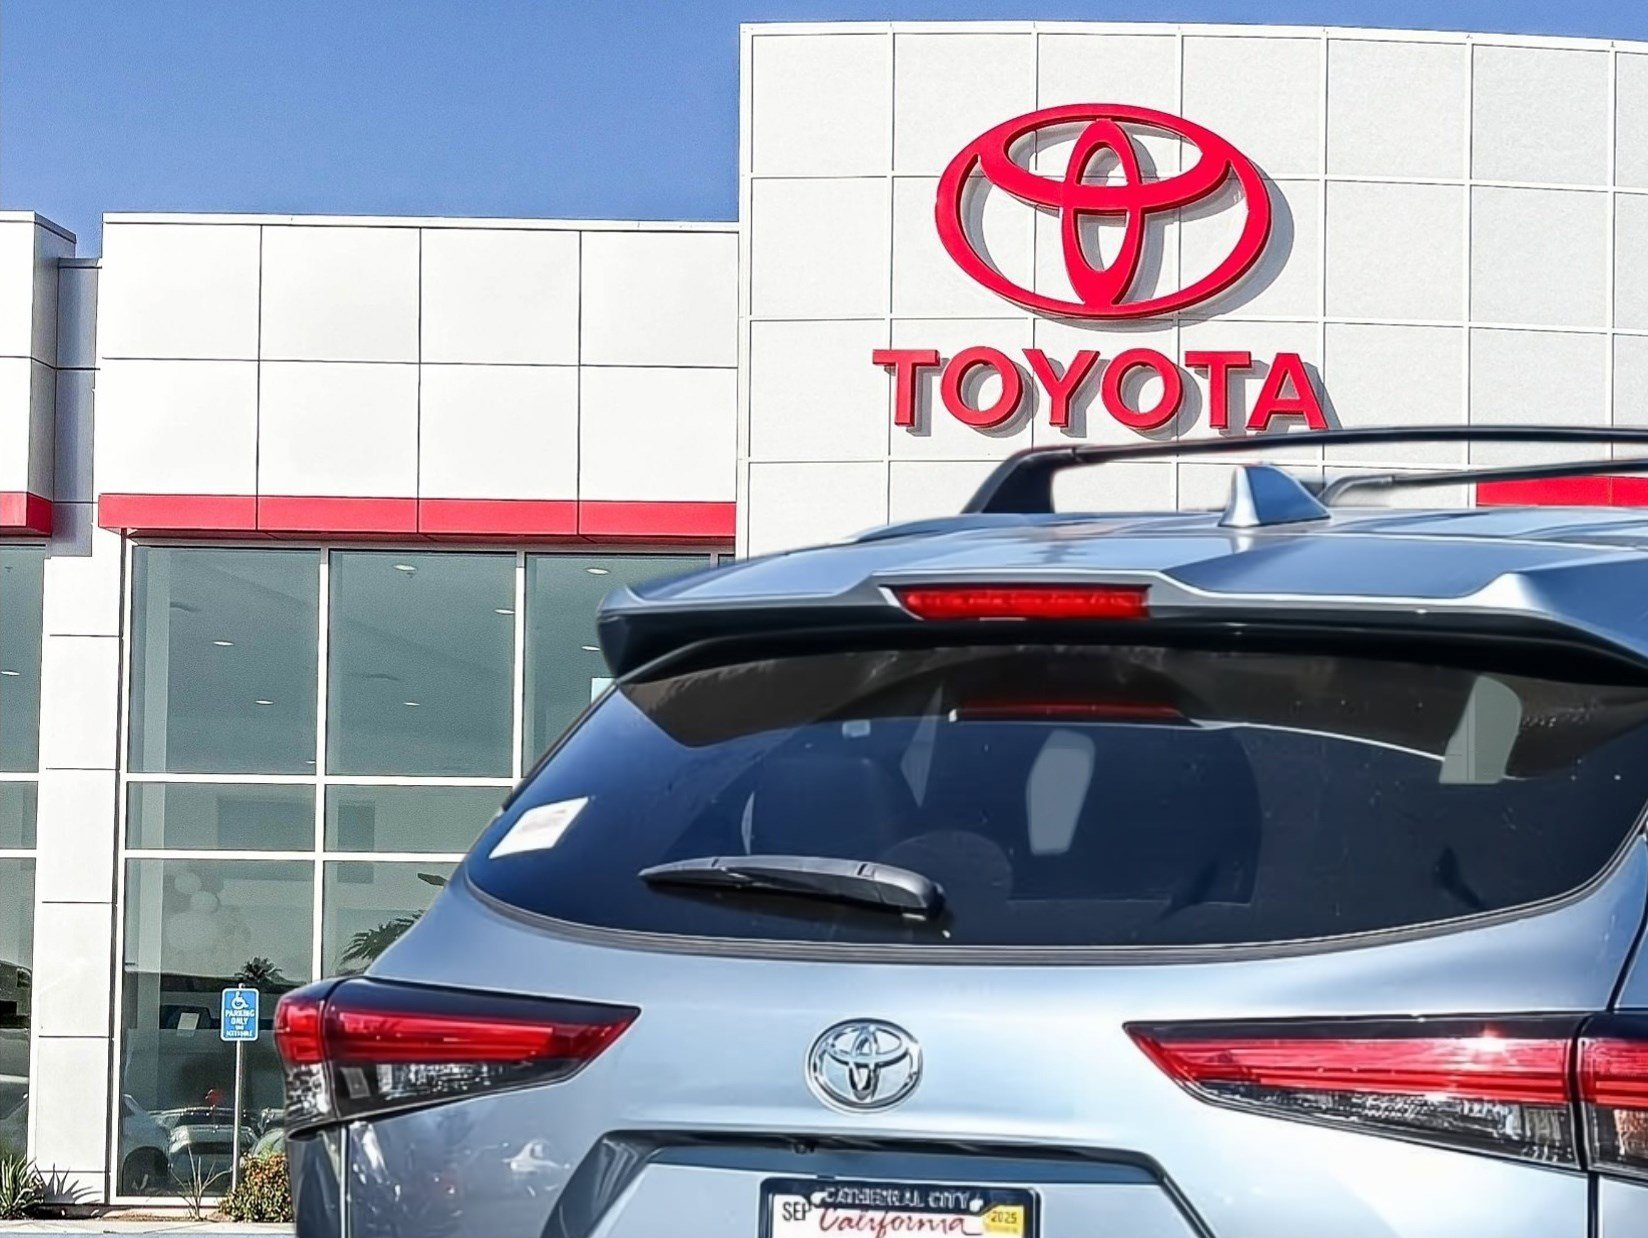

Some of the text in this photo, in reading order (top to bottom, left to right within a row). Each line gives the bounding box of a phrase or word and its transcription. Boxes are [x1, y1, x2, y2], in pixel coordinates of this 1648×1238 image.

[872, 345, 1328, 431] TOYOTA
[225, 1009, 255, 1017] PARKING
[782, 1201, 811, 1222] SEP
[991, 1210, 1018, 1224] 2025
